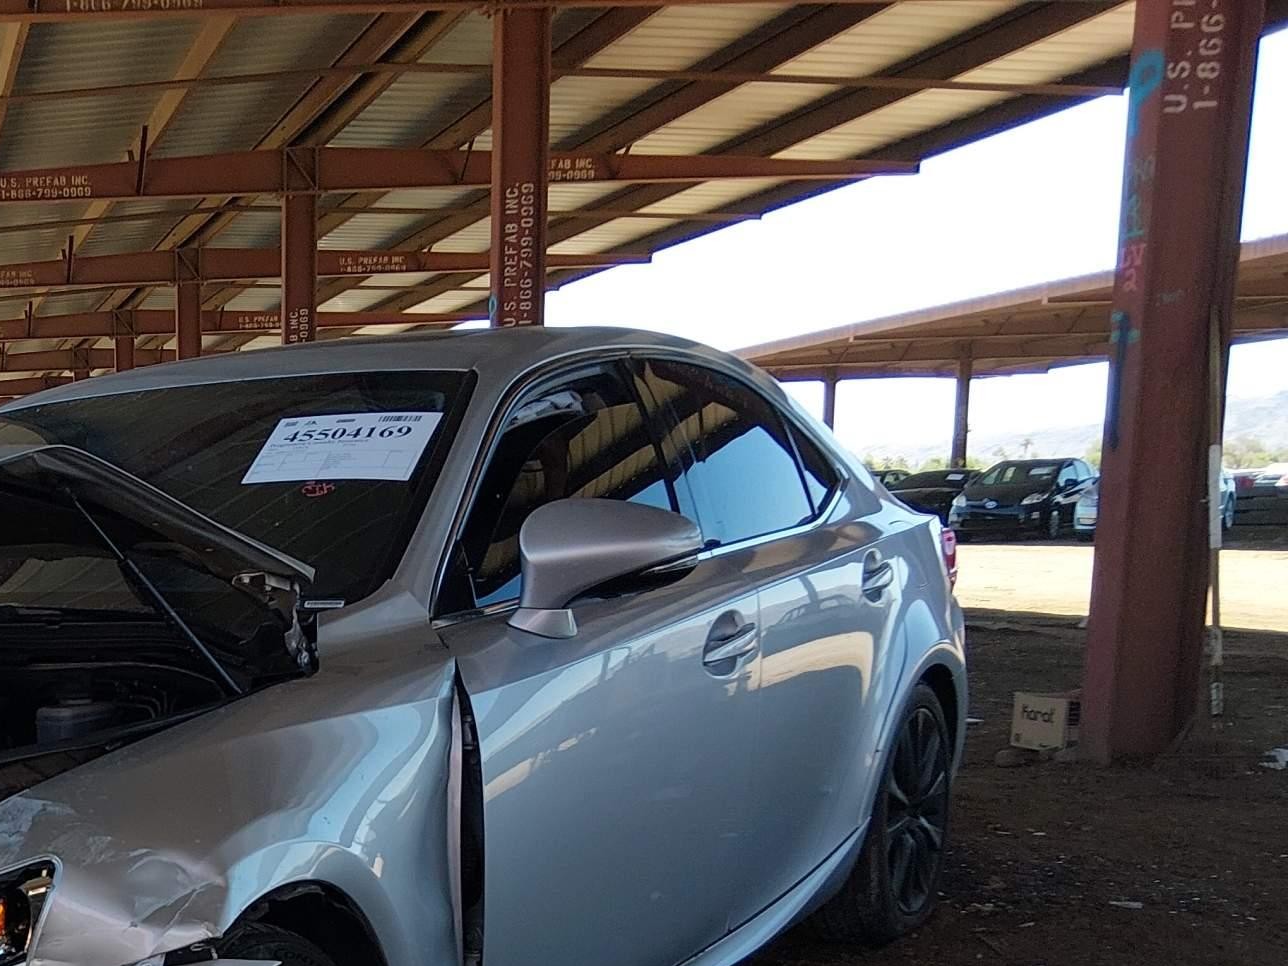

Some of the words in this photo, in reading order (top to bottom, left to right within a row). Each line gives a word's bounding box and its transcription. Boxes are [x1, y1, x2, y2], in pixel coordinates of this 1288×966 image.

[1171, 0, 1196, 29] P
[1163, 49, 1192, 114] U.S.
[25, 175, 67, 187] PREFAB
[505, 181, 519, 215] INC.
[504, 222, 518, 287] PREFAB
[518, 182, 535, 325] 1-866-799-0969
[283, 425, 412, 442] 45504169
